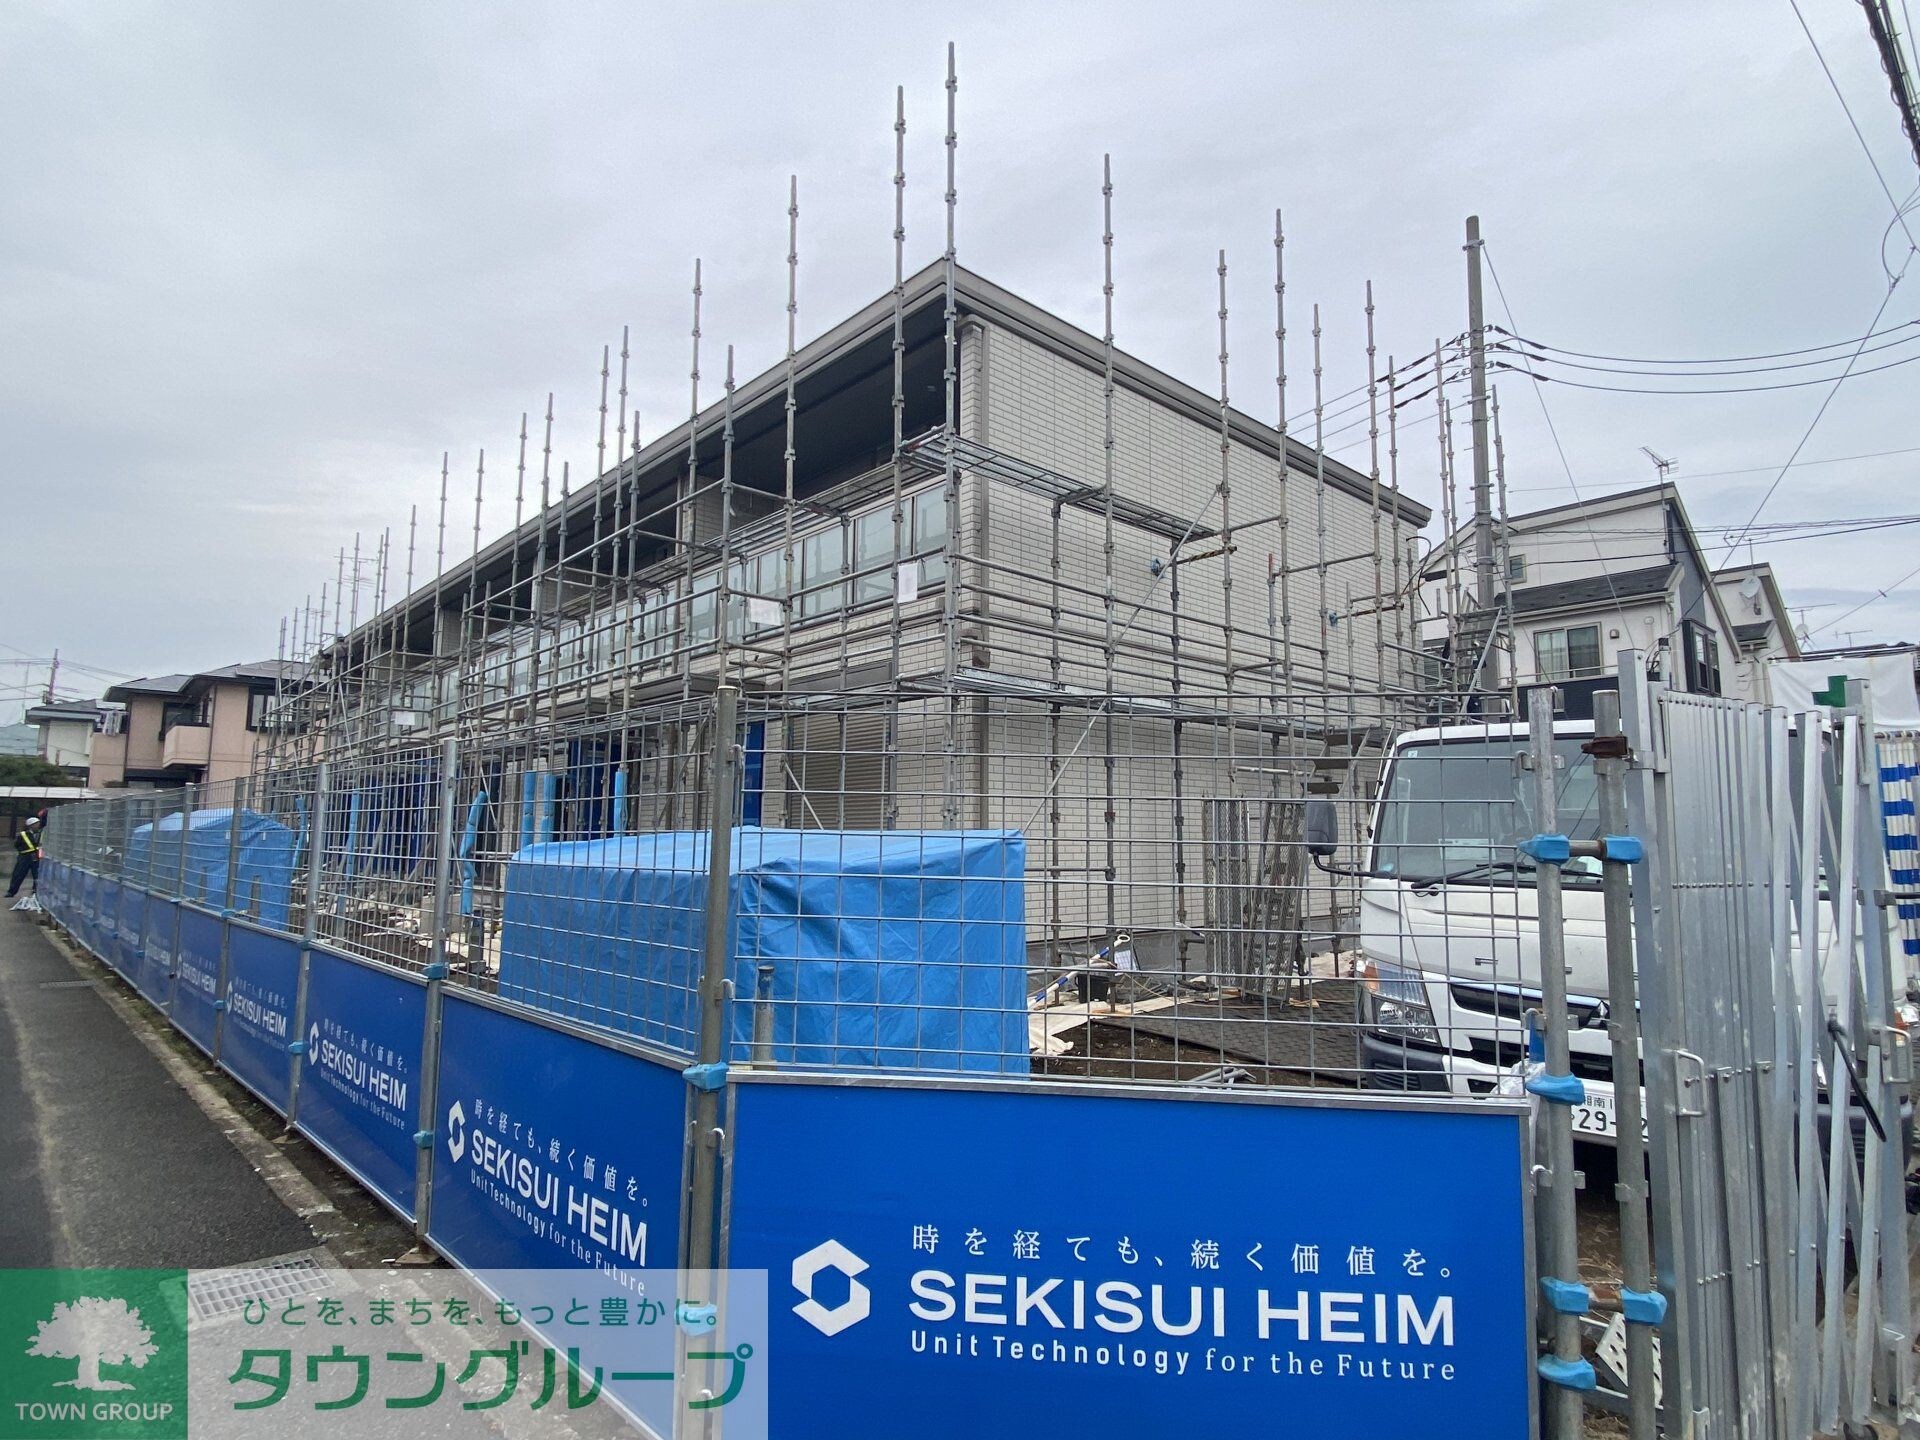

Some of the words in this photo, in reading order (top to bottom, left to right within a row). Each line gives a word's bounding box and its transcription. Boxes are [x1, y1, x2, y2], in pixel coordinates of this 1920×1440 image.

[262, 1008, 287, 1038] HEIM
[321, 1039, 367, 1089] SEKISUI
[368, 1066, 407, 1112] HEIM
[474, 1099, 648, 1207] 時を経ても、続く価値を。
[470, 1168, 488, 1192] Unit
[489, 1182, 546, 1238] Technology
[549, 1222, 567, 1248] for
[570, 1238, 591, 1264] the
[595, 1250, 645, 1296] Future
[471, 1129, 559, 1216] SEKISUI
[567, 1185, 648, 1267] HEIM
[912, 1224, 1452, 1279] 時を経ても、続く価値を。
[908, 1269, 1225, 1338] SEKISUI
[1258, 1289, 1454, 1346] HEIM
[911, 1329, 980, 1357] Unit
[992, 1336, 1190, 1376] Technology
[1205, 1347, 1255, 1374] for
[1270, 1350, 1323, 1377] the
[1337, 1354, 1455, 1381] Future
